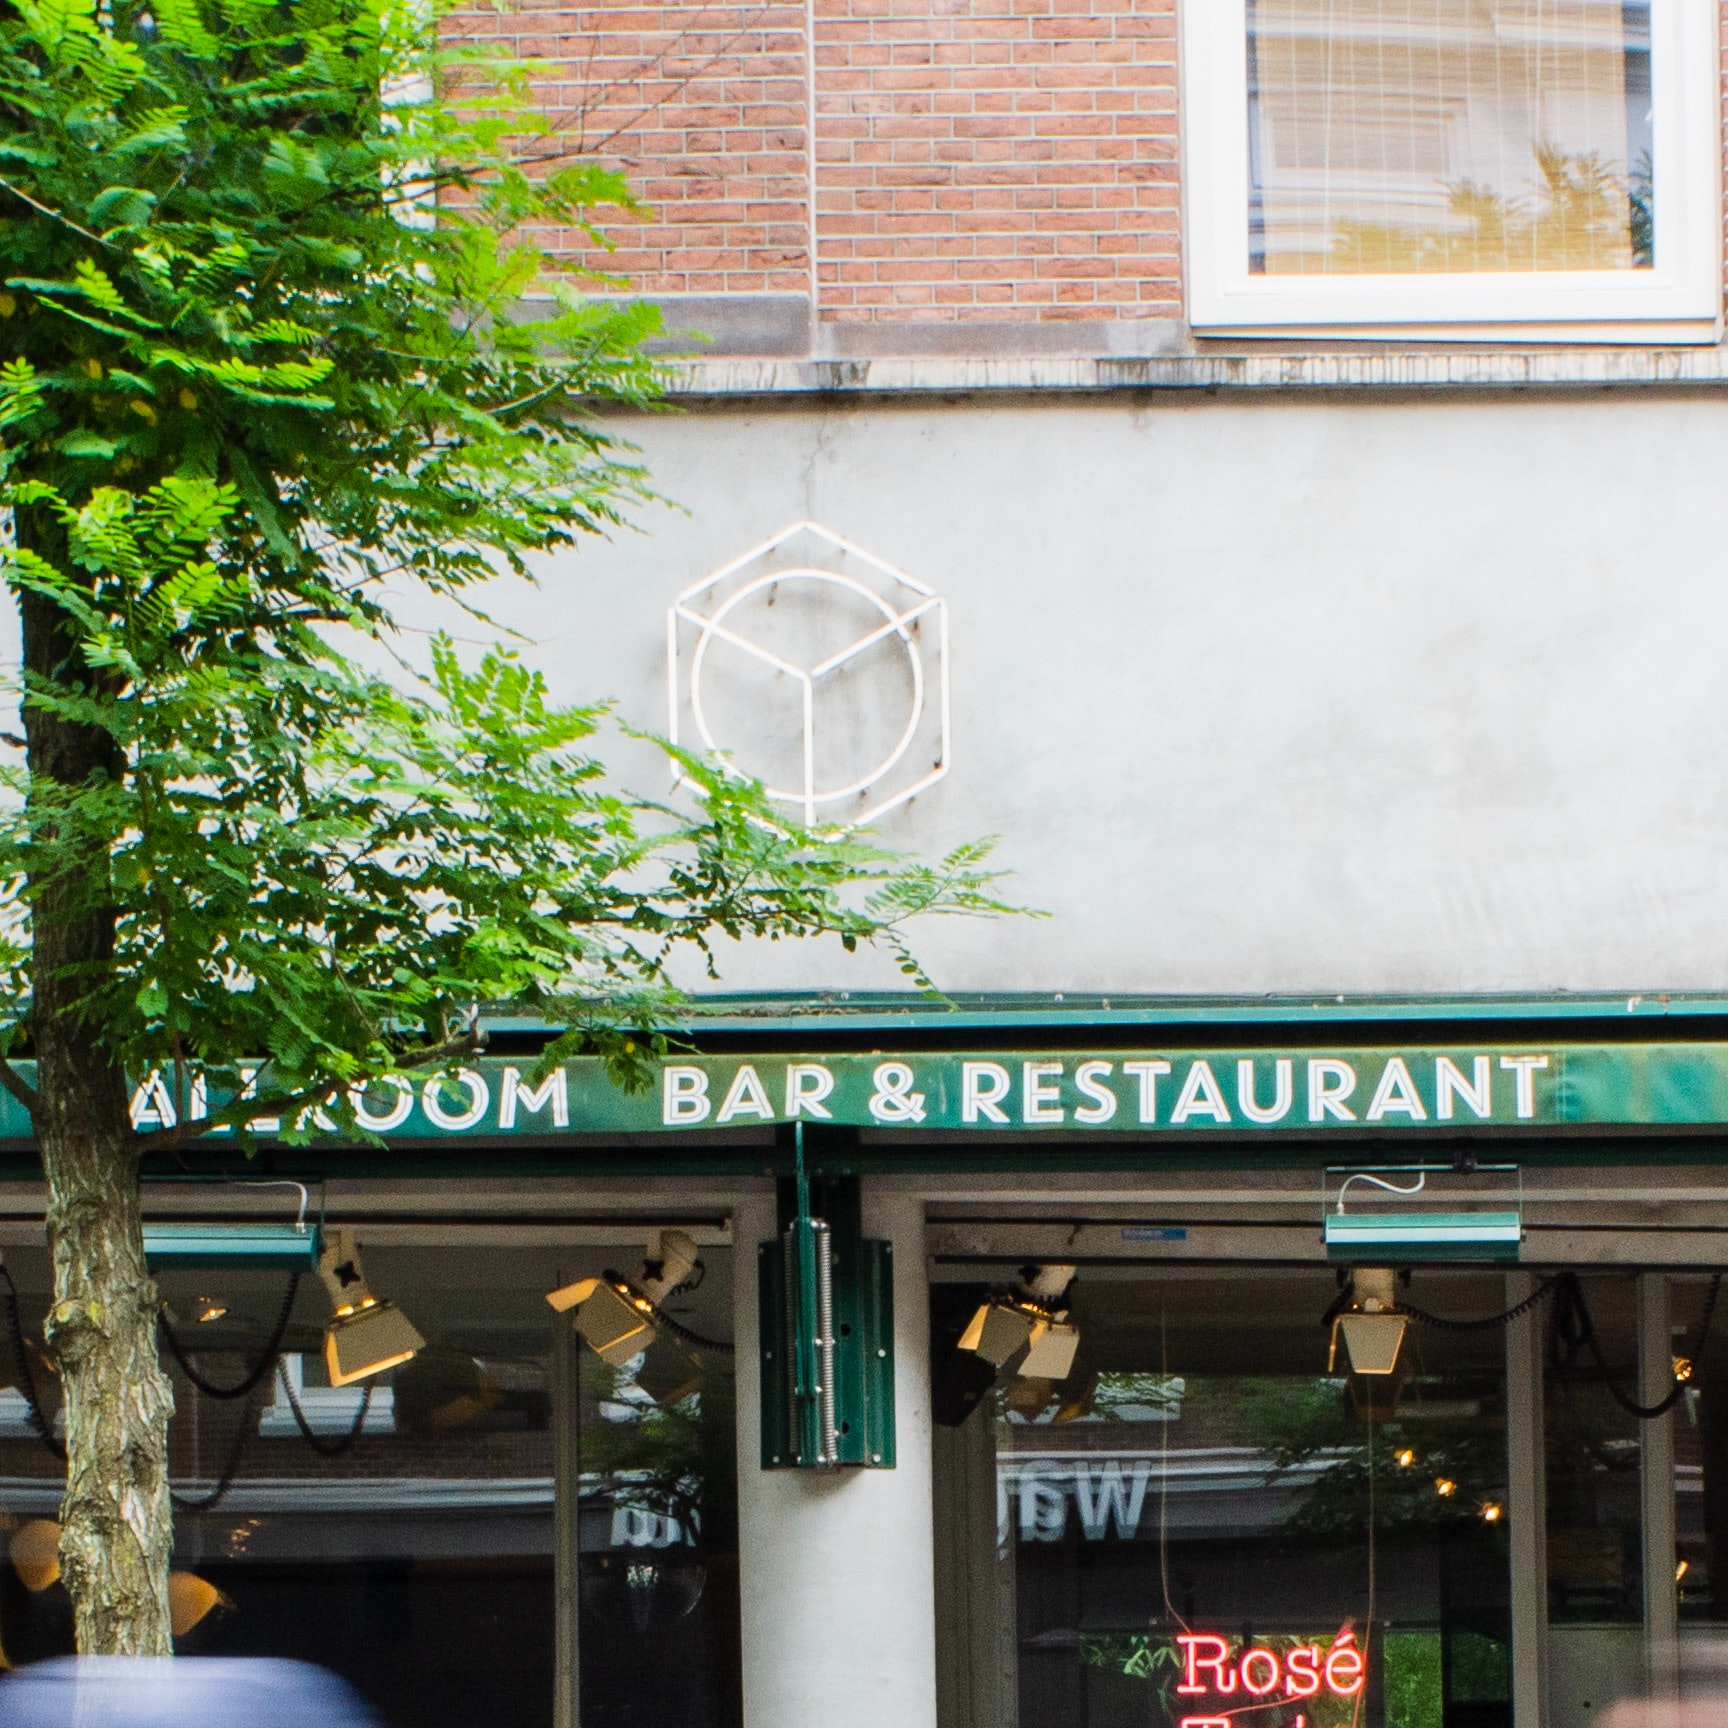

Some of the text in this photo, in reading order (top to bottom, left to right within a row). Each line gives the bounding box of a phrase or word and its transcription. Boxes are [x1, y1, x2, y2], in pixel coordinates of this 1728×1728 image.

[663, 1064, 835, 1126] BAR
[869, 1062, 927, 1124] &
[962, 1056, 1549, 1125] RESTAURANT
[1175, 1631, 1365, 1696] Rosé
